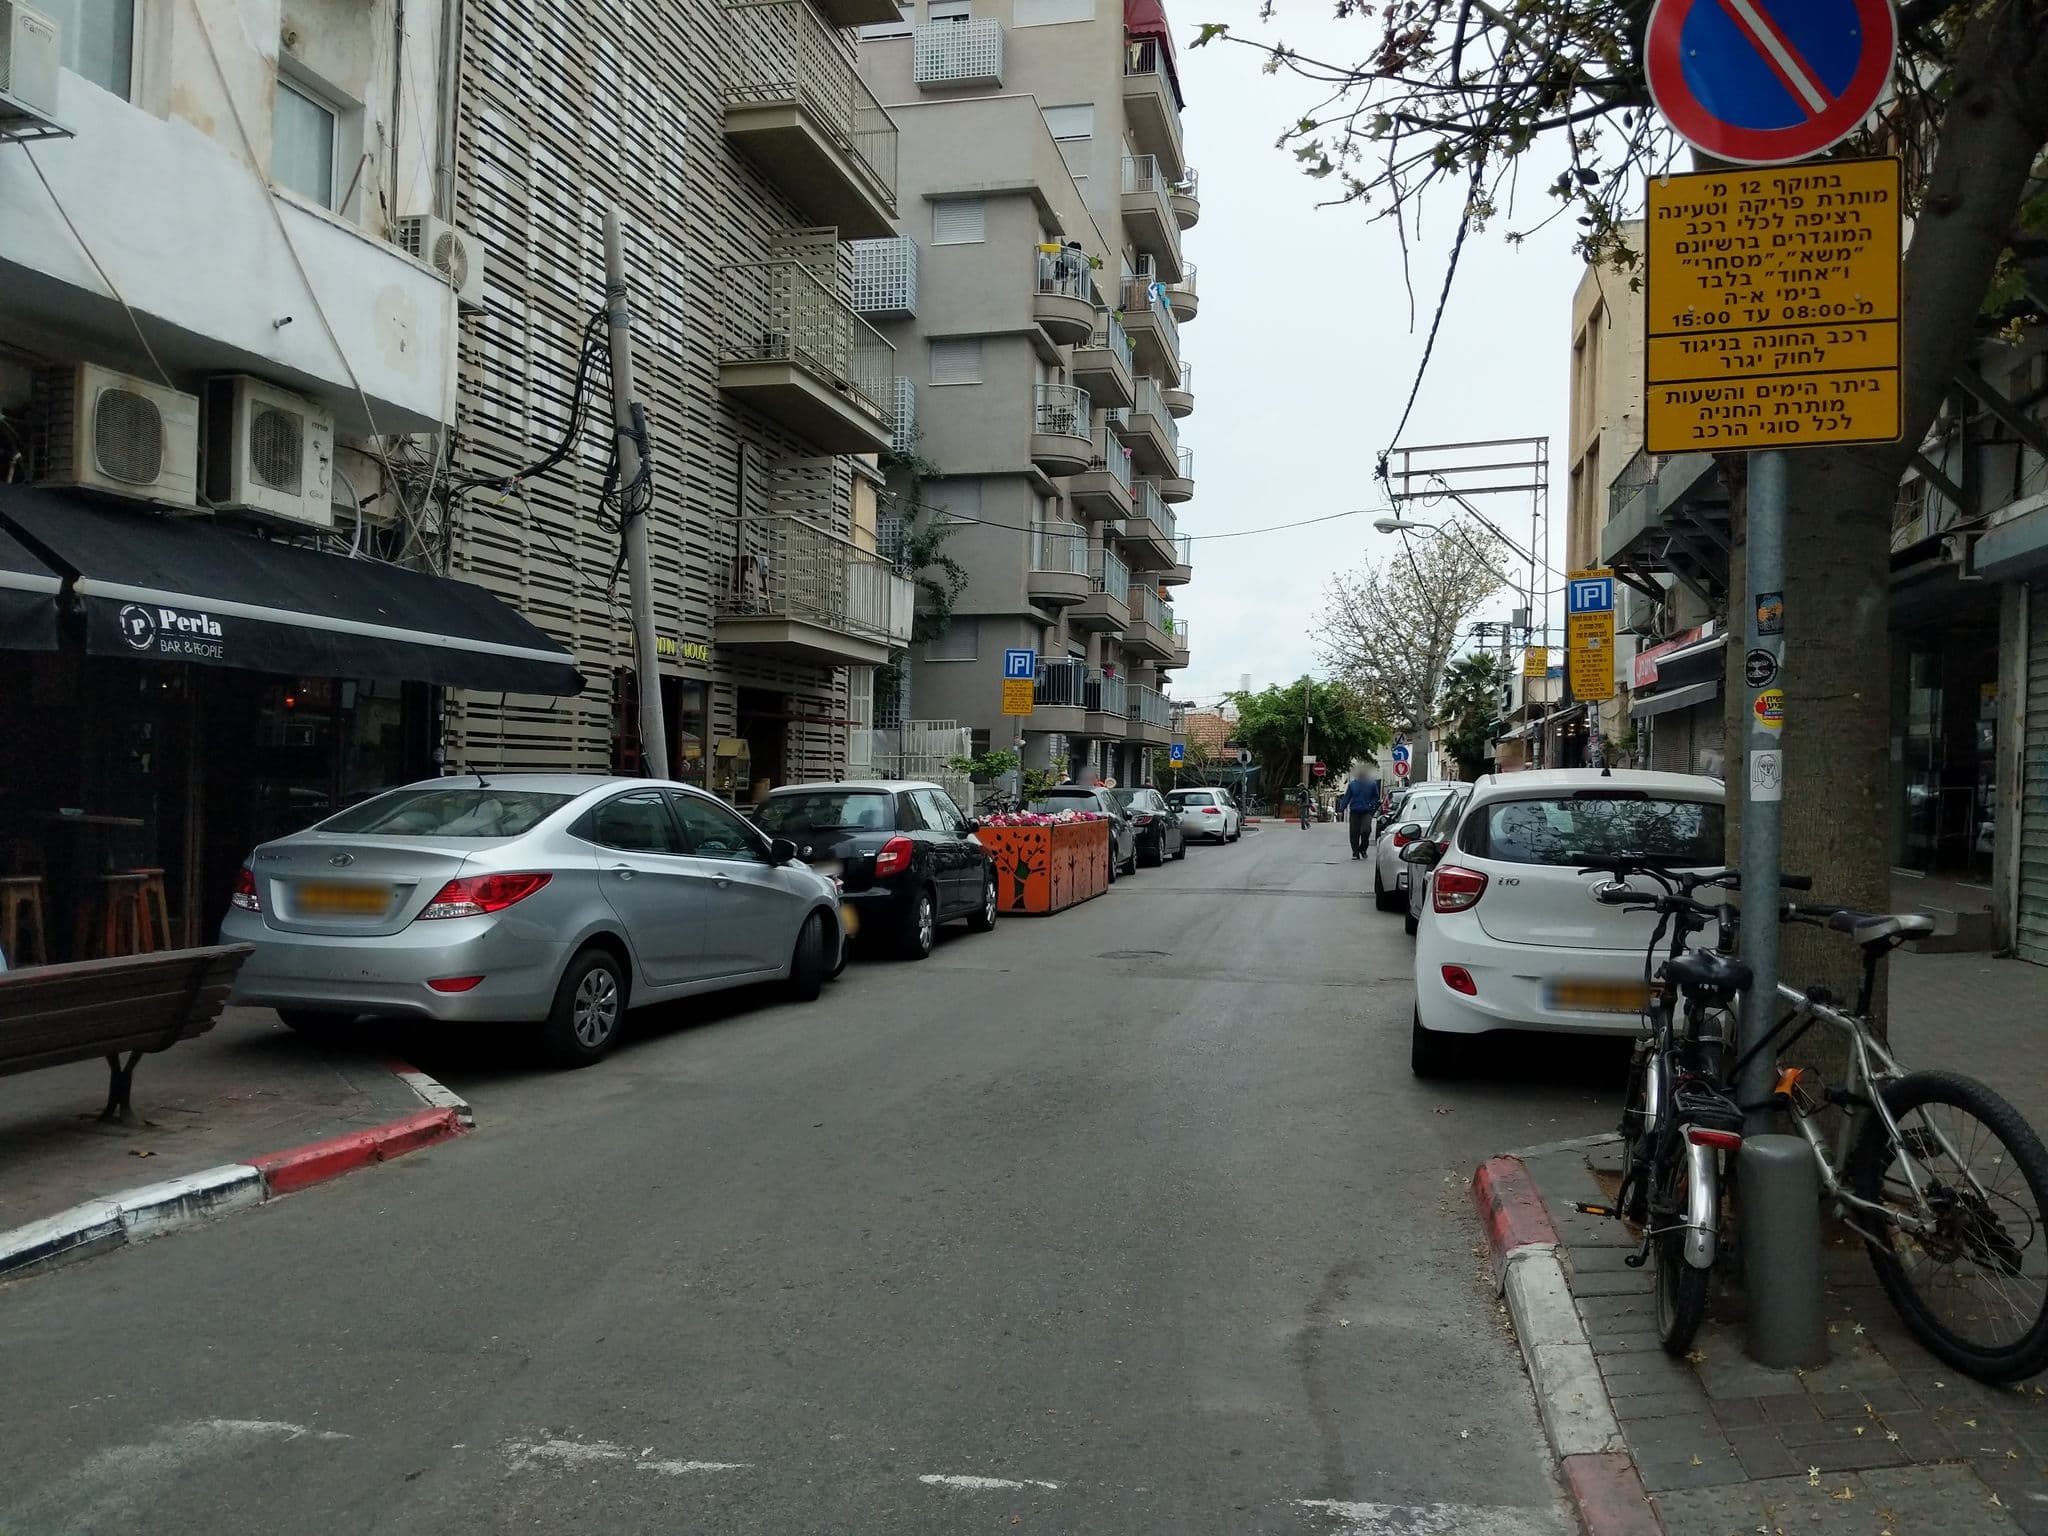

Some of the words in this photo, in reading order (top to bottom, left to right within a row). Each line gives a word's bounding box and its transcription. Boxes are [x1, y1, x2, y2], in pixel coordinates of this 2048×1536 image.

[1740, 180, 1761, 195] 12
[1773, 174, 1842, 194] בתוקף
[1739, 196, 1804, 215] פריקה
[1817, 189, 1888, 207] מותרת
[1658, 201, 1727, 220] וטעינה
[1795, 210, 1860, 228] רציפה
[1686, 220, 1726, 236] רכב
[1737, 212, 1784, 231] לכלי
[1675, 235, 1760, 255] ברשיונם
[1772, 227, 1872, 247] המוגדרים
[1697, 272, 1753, 289] בלבד
[1776, 286, 1821, 301] בימי
[1672, 310, 1731, 328] 15:00
[1743, 308, 1770, 323] עד
[1679, 337, 1741, 354] בניגוד
[1753, 332, 1815, 348] החונה
[1827, 329, 1867, 345] רכב
[1719, 354, 1762, 369] יגרר
[1774, 346, 1825, 370] לחוק
[1756, 382, 1818, 399] הימים
[1830, 378, 1880, 394] ביתר
[1665, 386, 1744, 405] והשעות
[1700, 403, 1761, 420] החניה
[1774, 399, 1845, 416] מותרת
[1693, 422, 1748, 439] הרכב
[1759, 420, 1800, 434] סוגי
[1812, 413, 1852, 431] לכל
[158, 608, 223, 637] Perla
[160, 640, 182, 654] BAR
[193, 641, 224, 659] PEOPLE
[684, 641, 708, 662] HOUSE
[1498, 876, 1520, 887] i10
